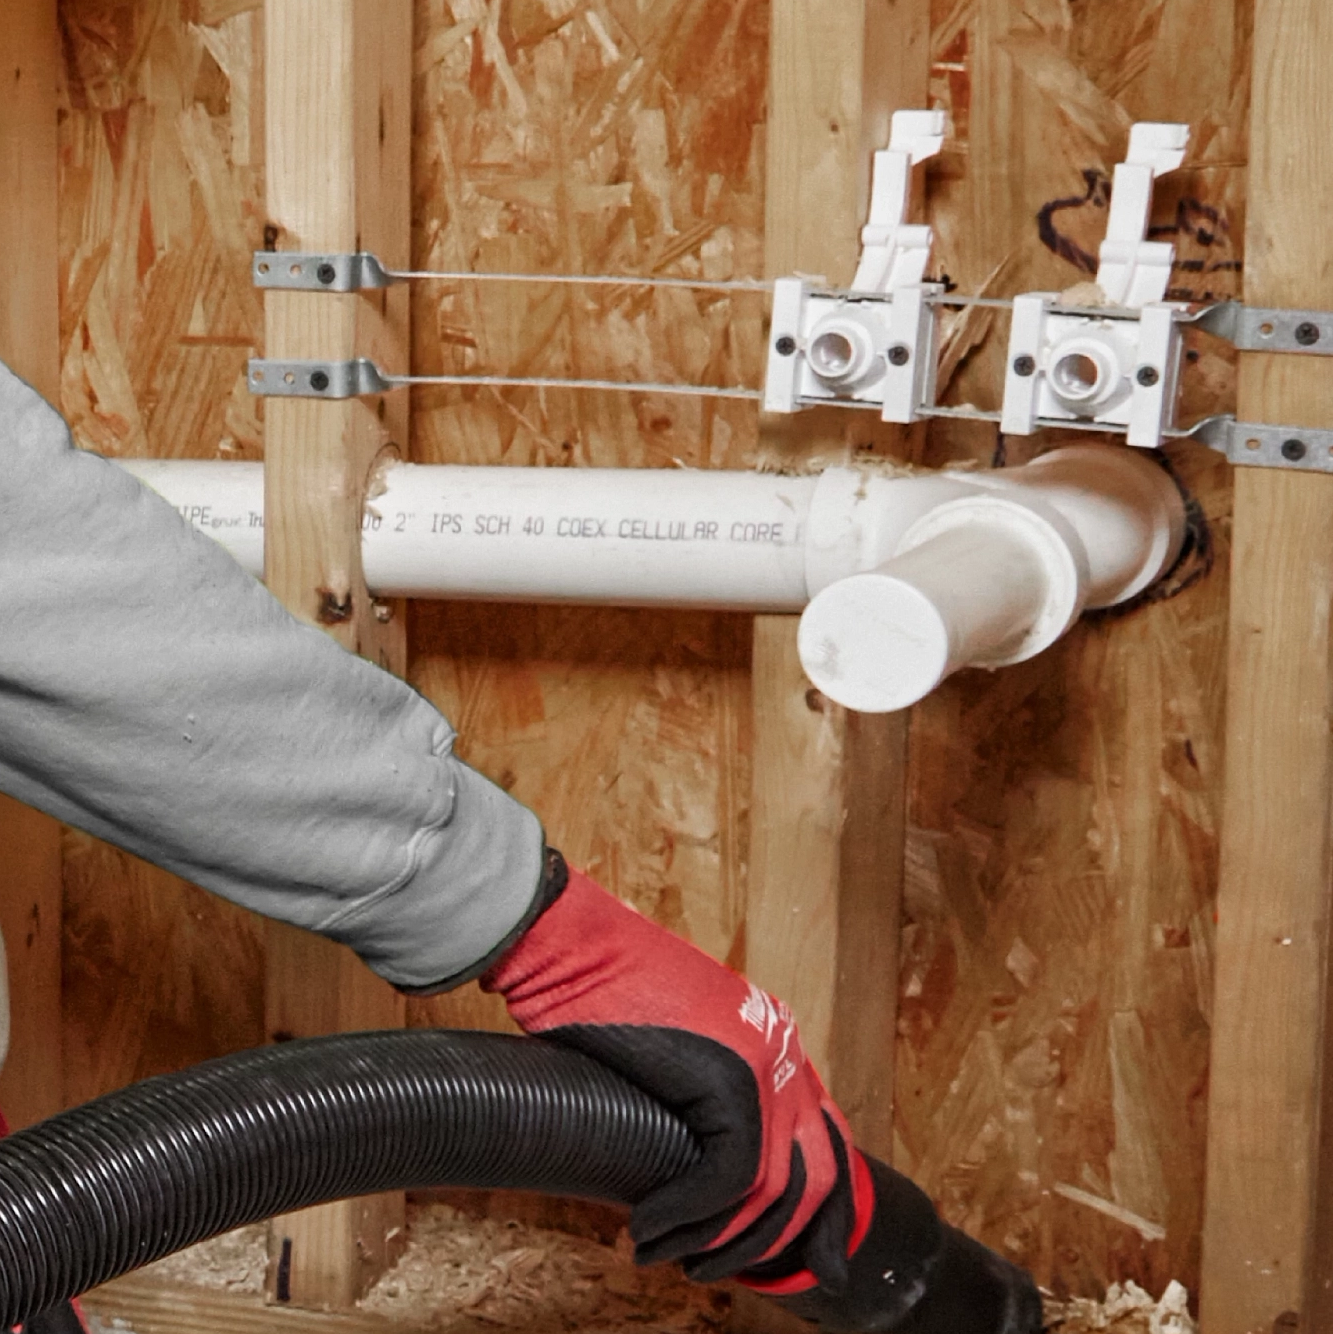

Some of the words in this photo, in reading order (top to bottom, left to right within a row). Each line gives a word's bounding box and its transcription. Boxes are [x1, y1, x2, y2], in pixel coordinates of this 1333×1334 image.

[431, 513, 463, 534] IPS
[474, 514, 511, 535] SCH
[522, 516, 545, 536] 40
[556, 517, 607, 538] COEX
[618, 519, 719, 540] CELLULAR
[730, 521, 783, 543] CORE
